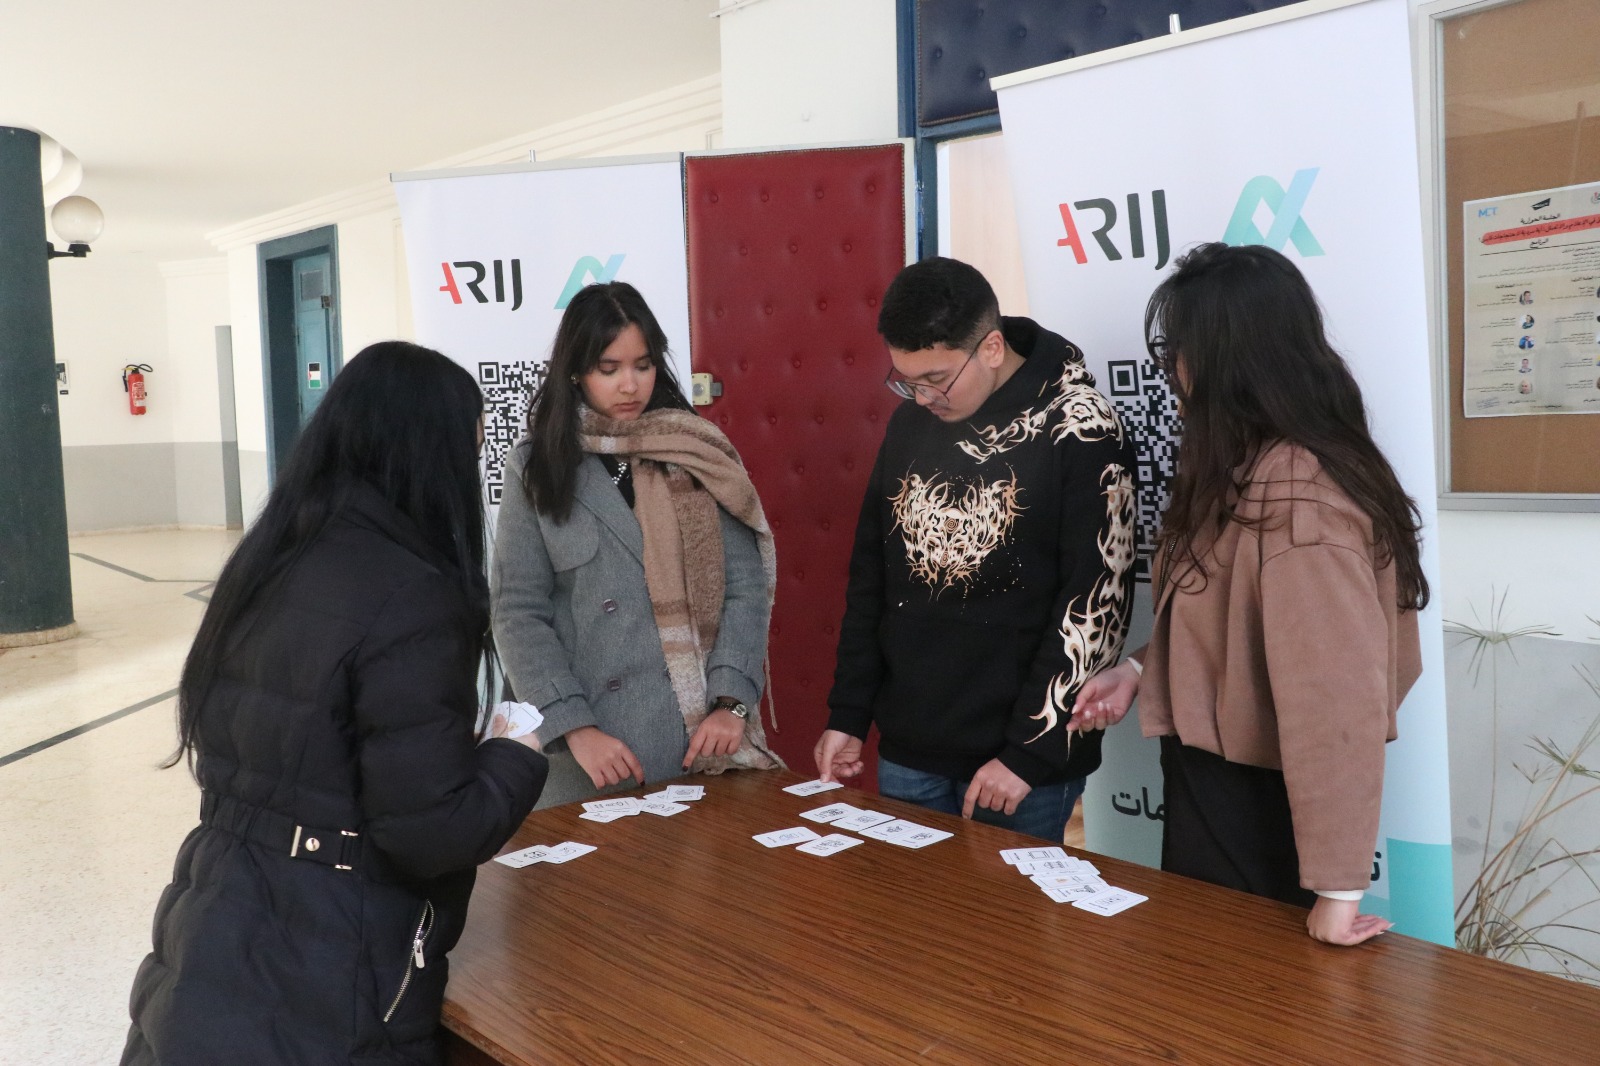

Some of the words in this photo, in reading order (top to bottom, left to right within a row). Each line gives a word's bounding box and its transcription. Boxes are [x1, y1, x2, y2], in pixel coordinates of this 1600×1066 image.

[1057, 189, 1171, 270] ARIJ
[439, 259, 523, 311] ARIJ
[1112, 786, 1165, 821] مات
